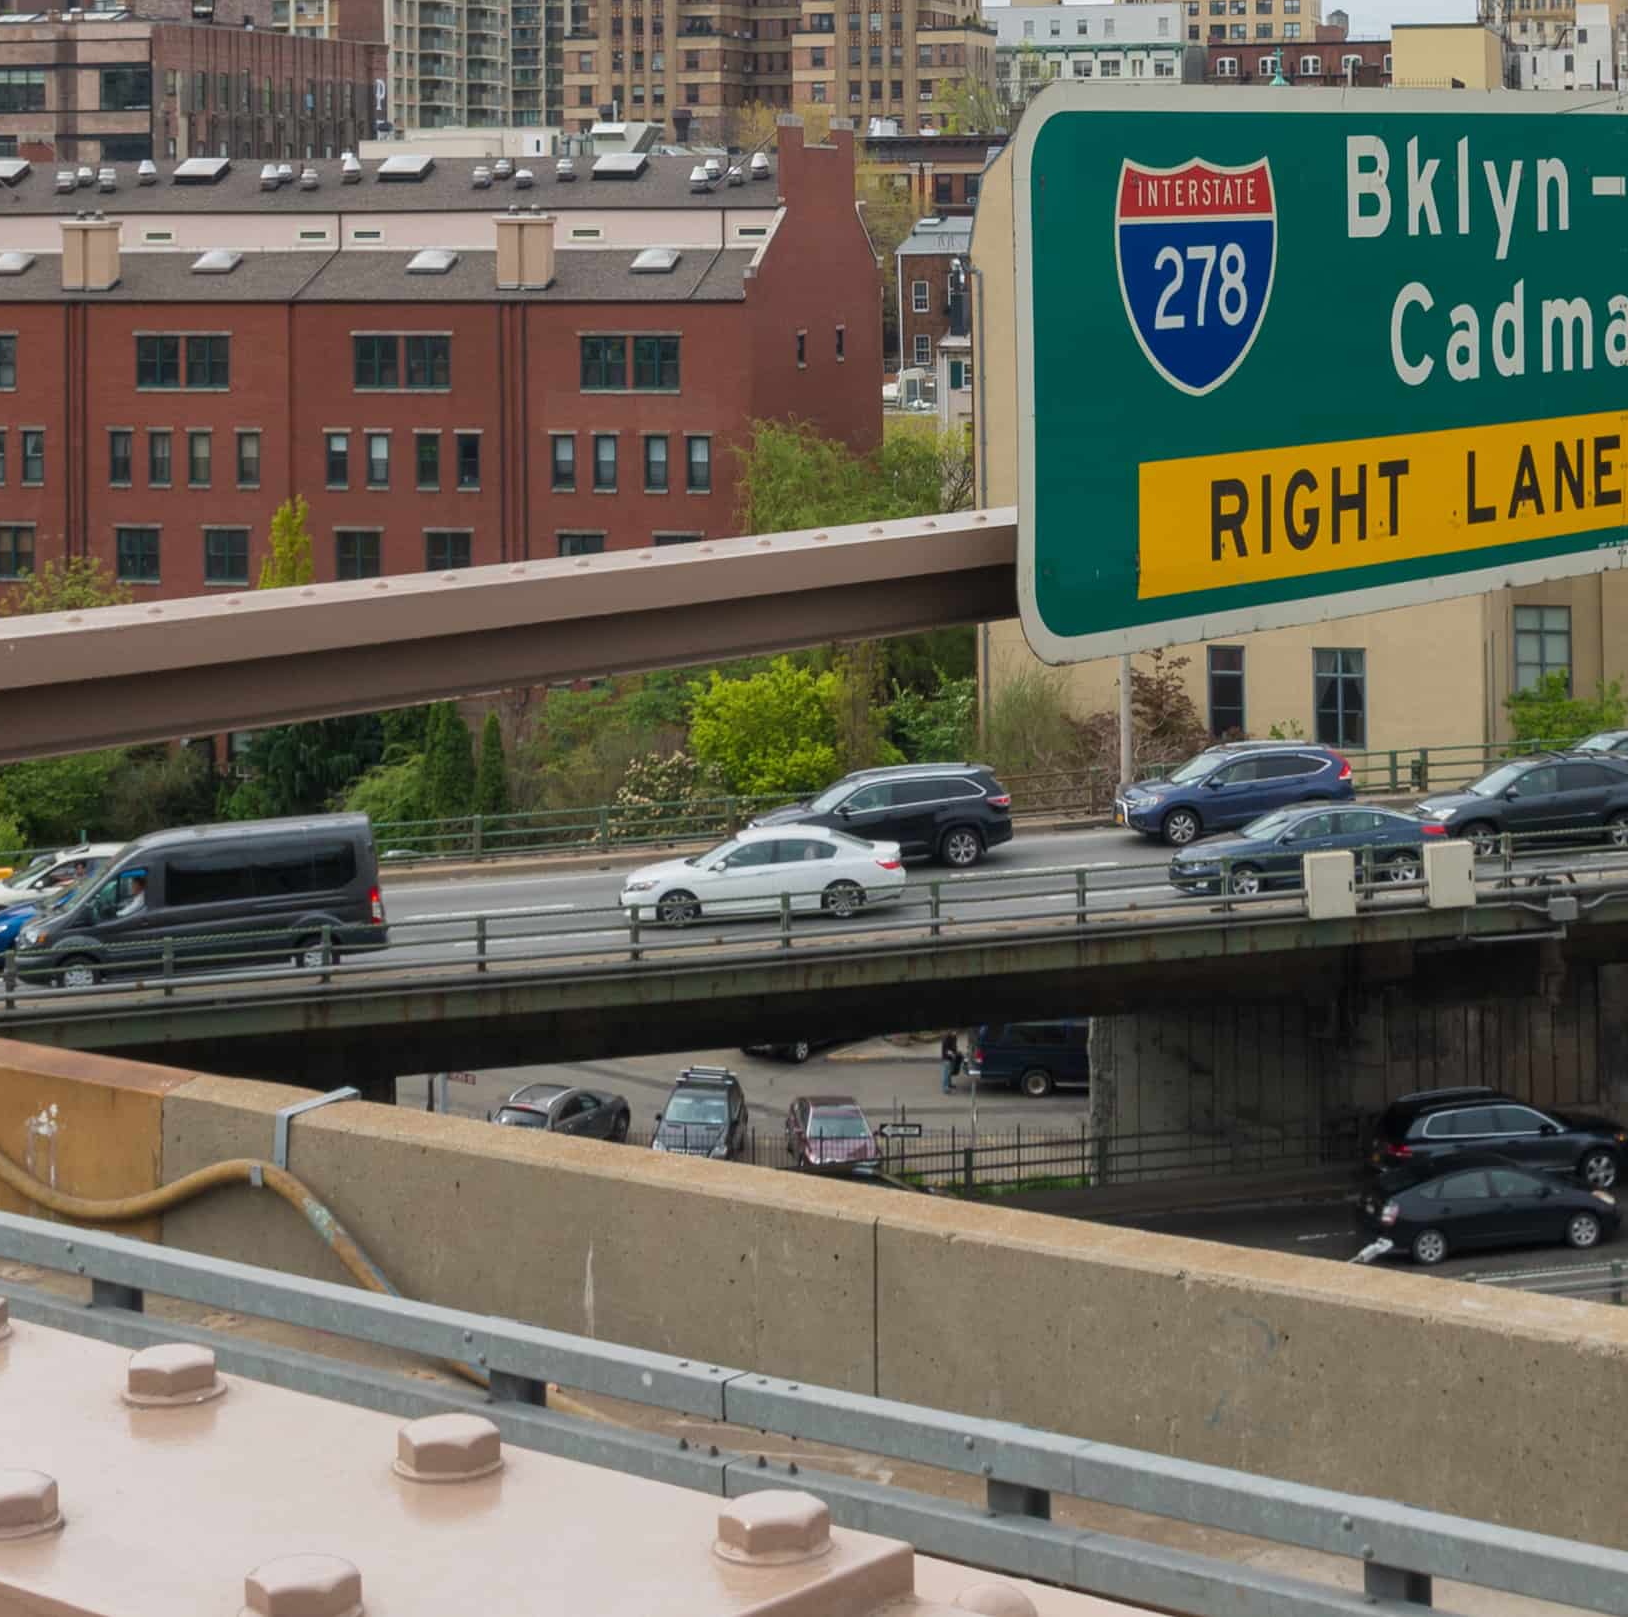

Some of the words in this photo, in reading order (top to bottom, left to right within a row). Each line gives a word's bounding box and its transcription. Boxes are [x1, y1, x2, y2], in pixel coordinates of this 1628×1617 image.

[1136, 177, 1256, 208] INTERSTATE
[1153, 243, 1248, 330] 278
[1209, 458, 1411, 562] RIGHT
[1466, 434, 1623, 525] LANE
